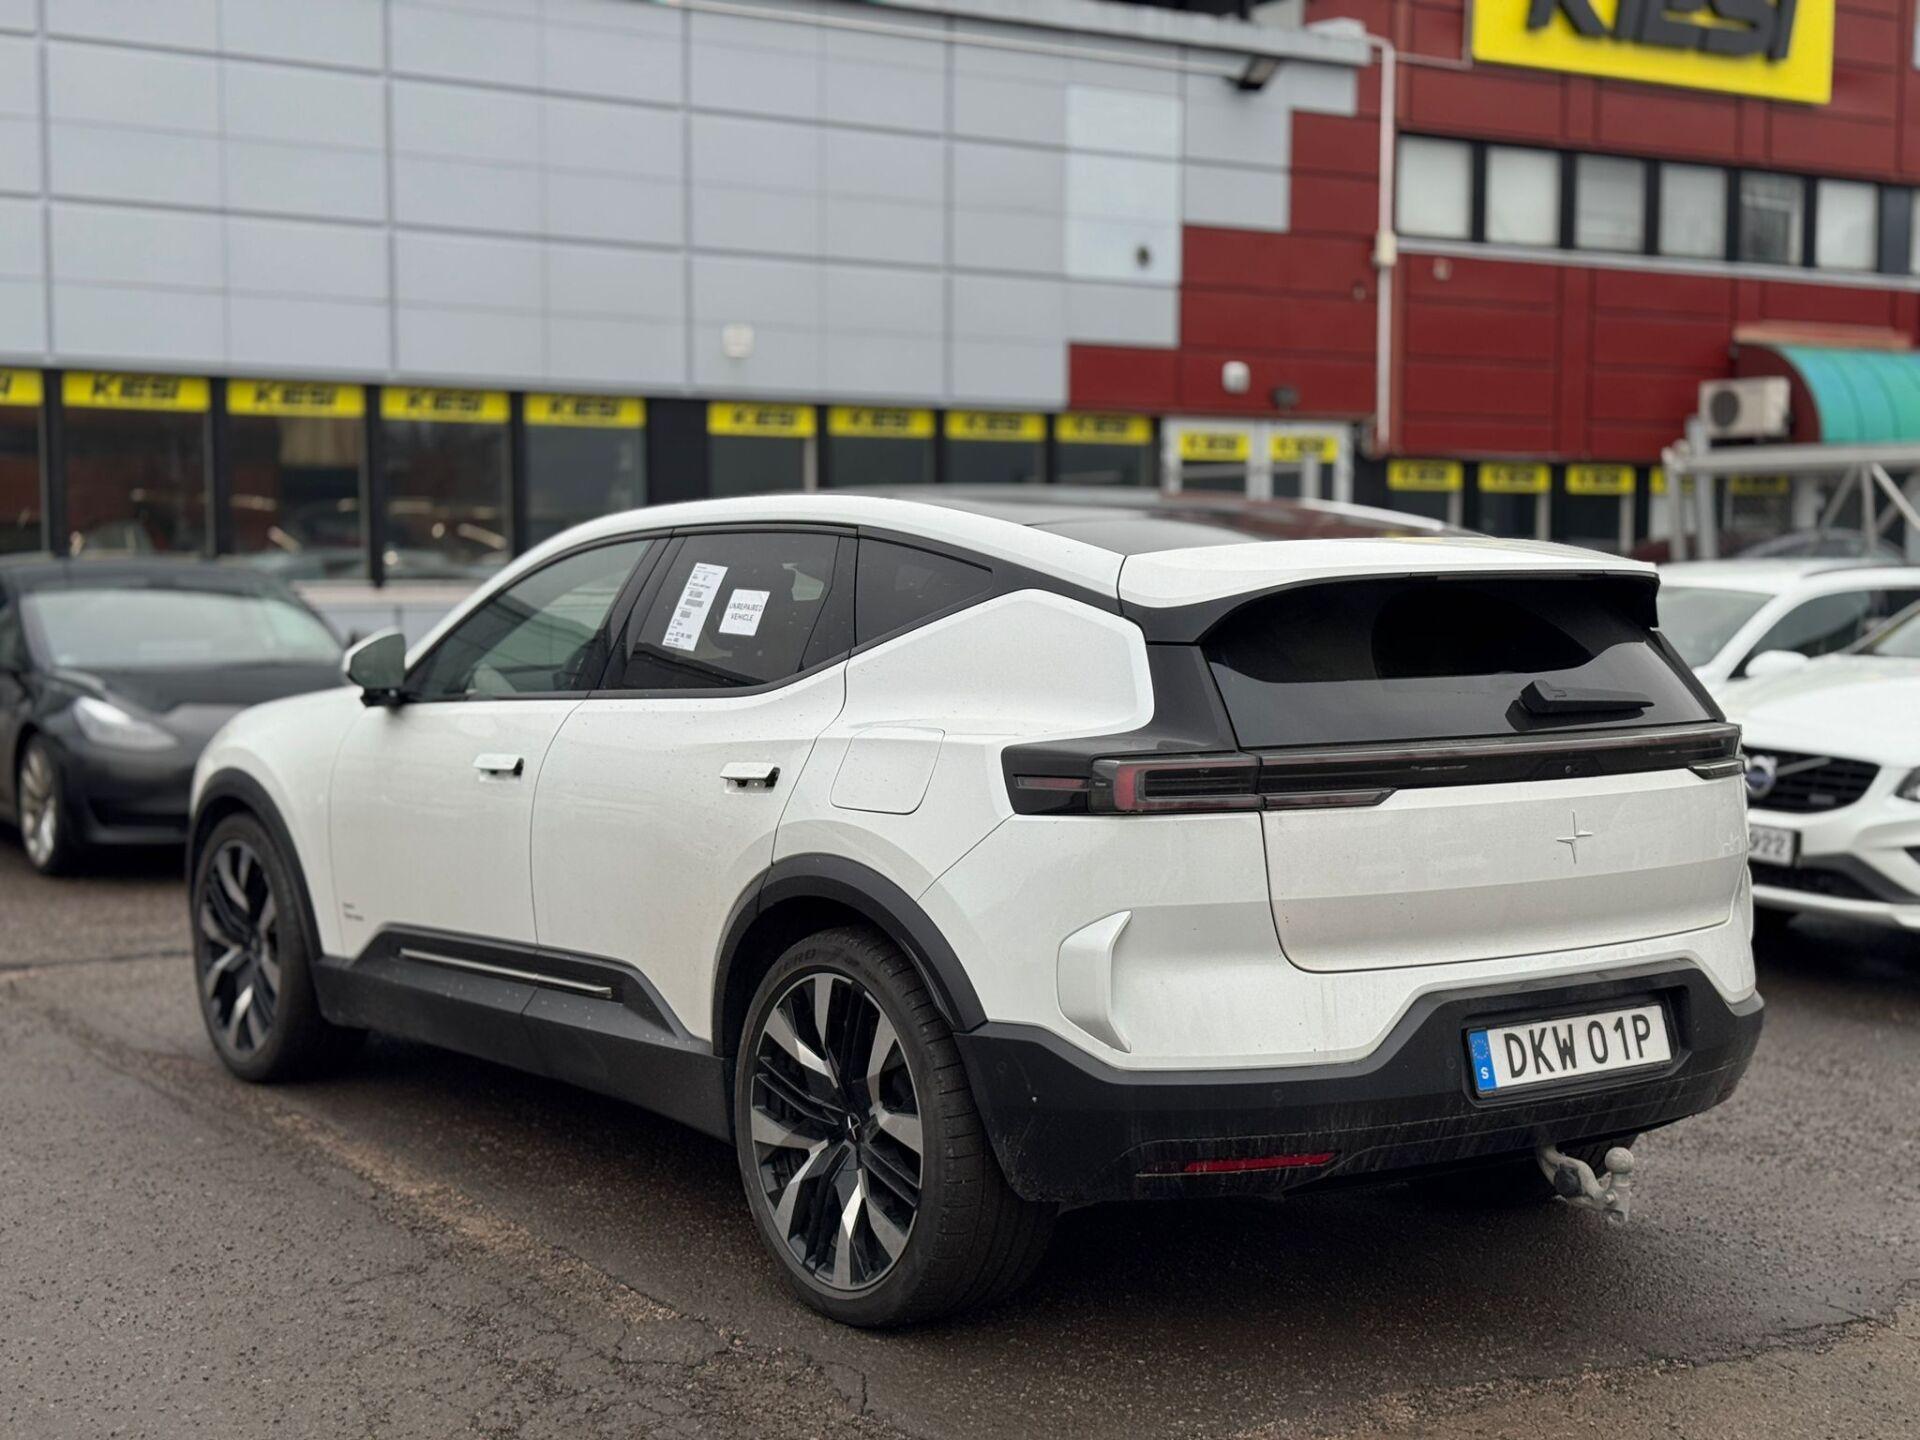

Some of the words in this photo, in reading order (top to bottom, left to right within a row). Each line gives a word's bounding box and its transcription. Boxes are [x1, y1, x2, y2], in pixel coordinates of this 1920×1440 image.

[729, 602, 763, 612] UNREPAIRED
[730, 612, 754, 622] VEHICLE
[1481, 1066, 1490, 1080] S
[1504, 1024, 1578, 1079] DKW
[1587, 1013, 1651, 1064] 01P
